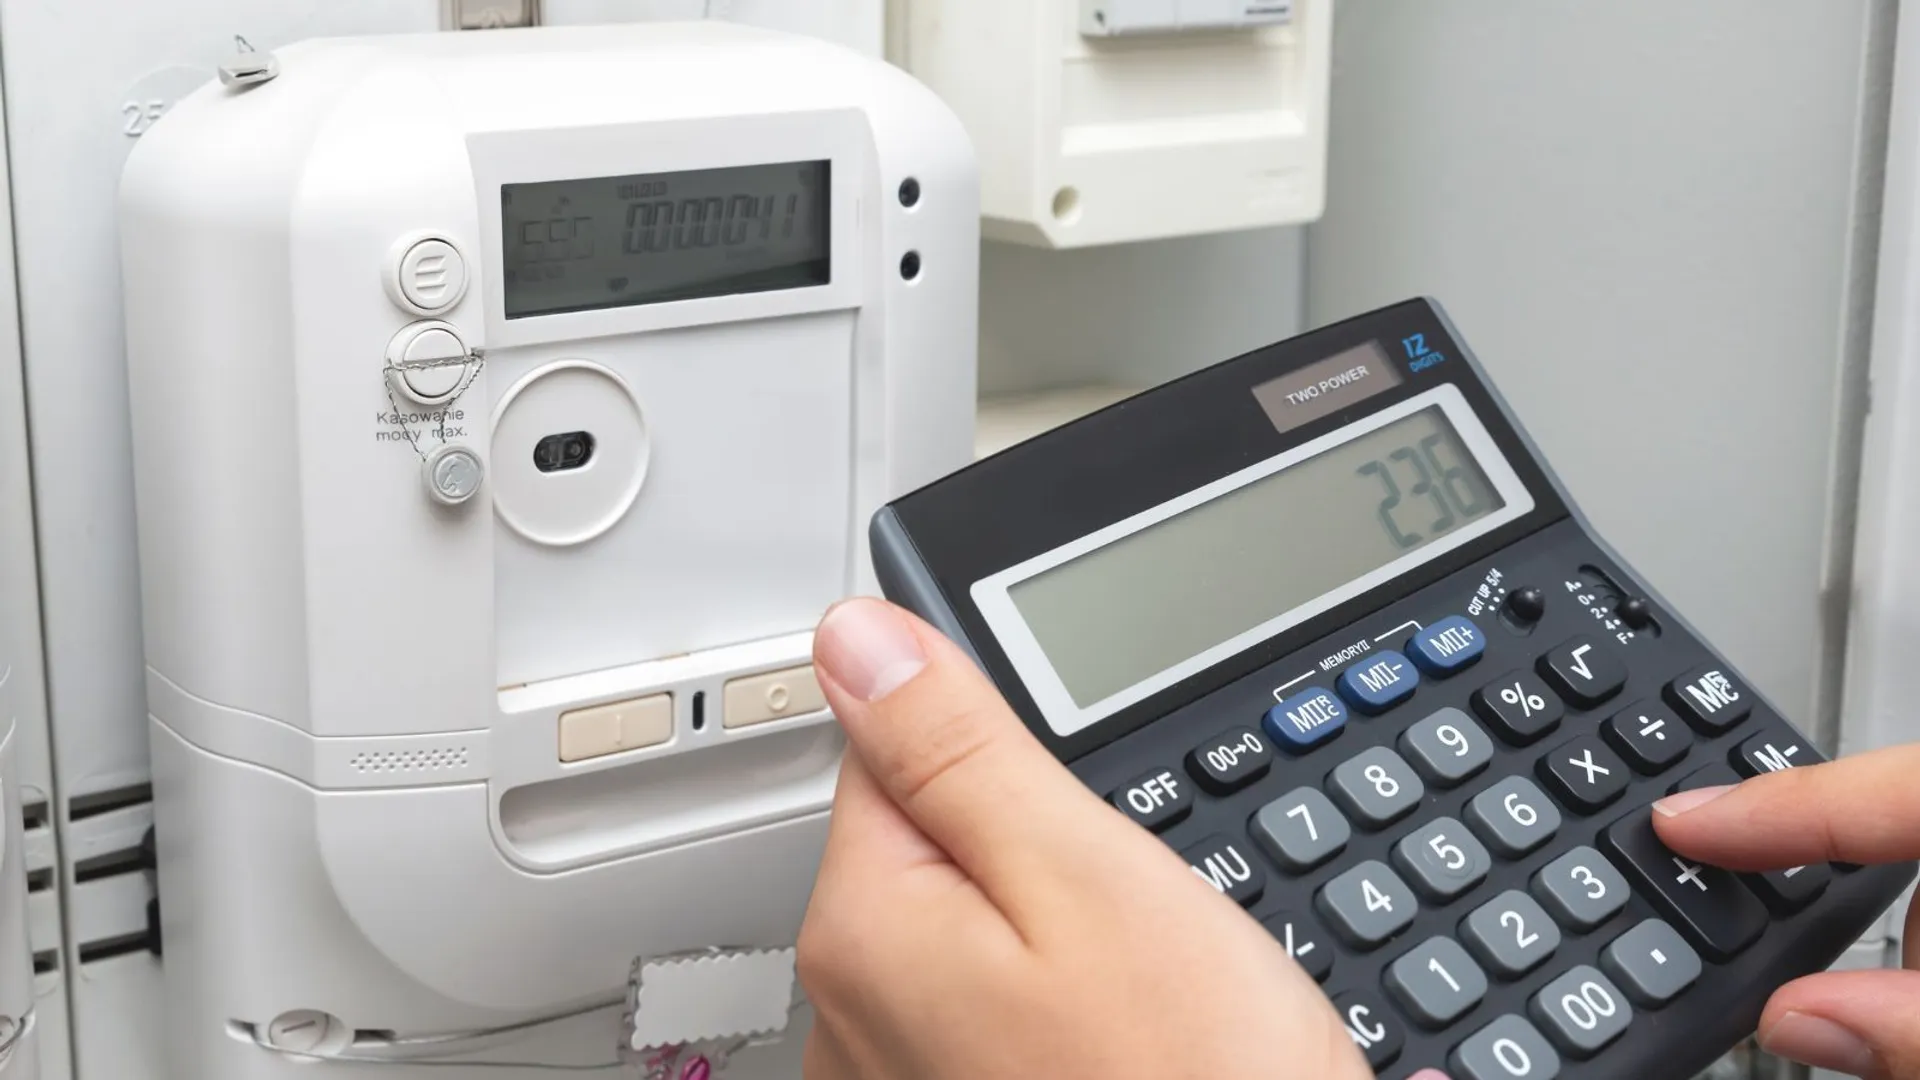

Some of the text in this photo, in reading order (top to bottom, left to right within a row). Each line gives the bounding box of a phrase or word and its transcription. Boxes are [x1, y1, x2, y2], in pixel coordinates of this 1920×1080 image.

[1402, 333, 1430, 358] 12
[1409, 351, 1446, 373] DIGITS
[1285, 364, 1370, 406] TWO POWER
[376, 409, 465, 424] Kasowanie
[1356, 432, 1486, 548] 236
[1467, 567, 1503, 617] CUT UP 5/4
[1436, 723, 1470, 757] 9
[1126, 771, 1179, 815] OFF
[1363, 764, 1400, 798] 8
[1286, 803, 1319, 841] 7
[1503, 792, 1538, 827] 6
[1190, 844, 1252, 894] MU
[1427, 833, 1466, 870] 5
[1360, 878, 1393, 913] 4
[1570, 864, 1607, 900] 3
[1499, 909, 1540, 949] 2
[1428, 957, 1461, 993] 1
[1561, 981, 1617, 1030] 00
[1492, 1037, 1532, 1077] 0
